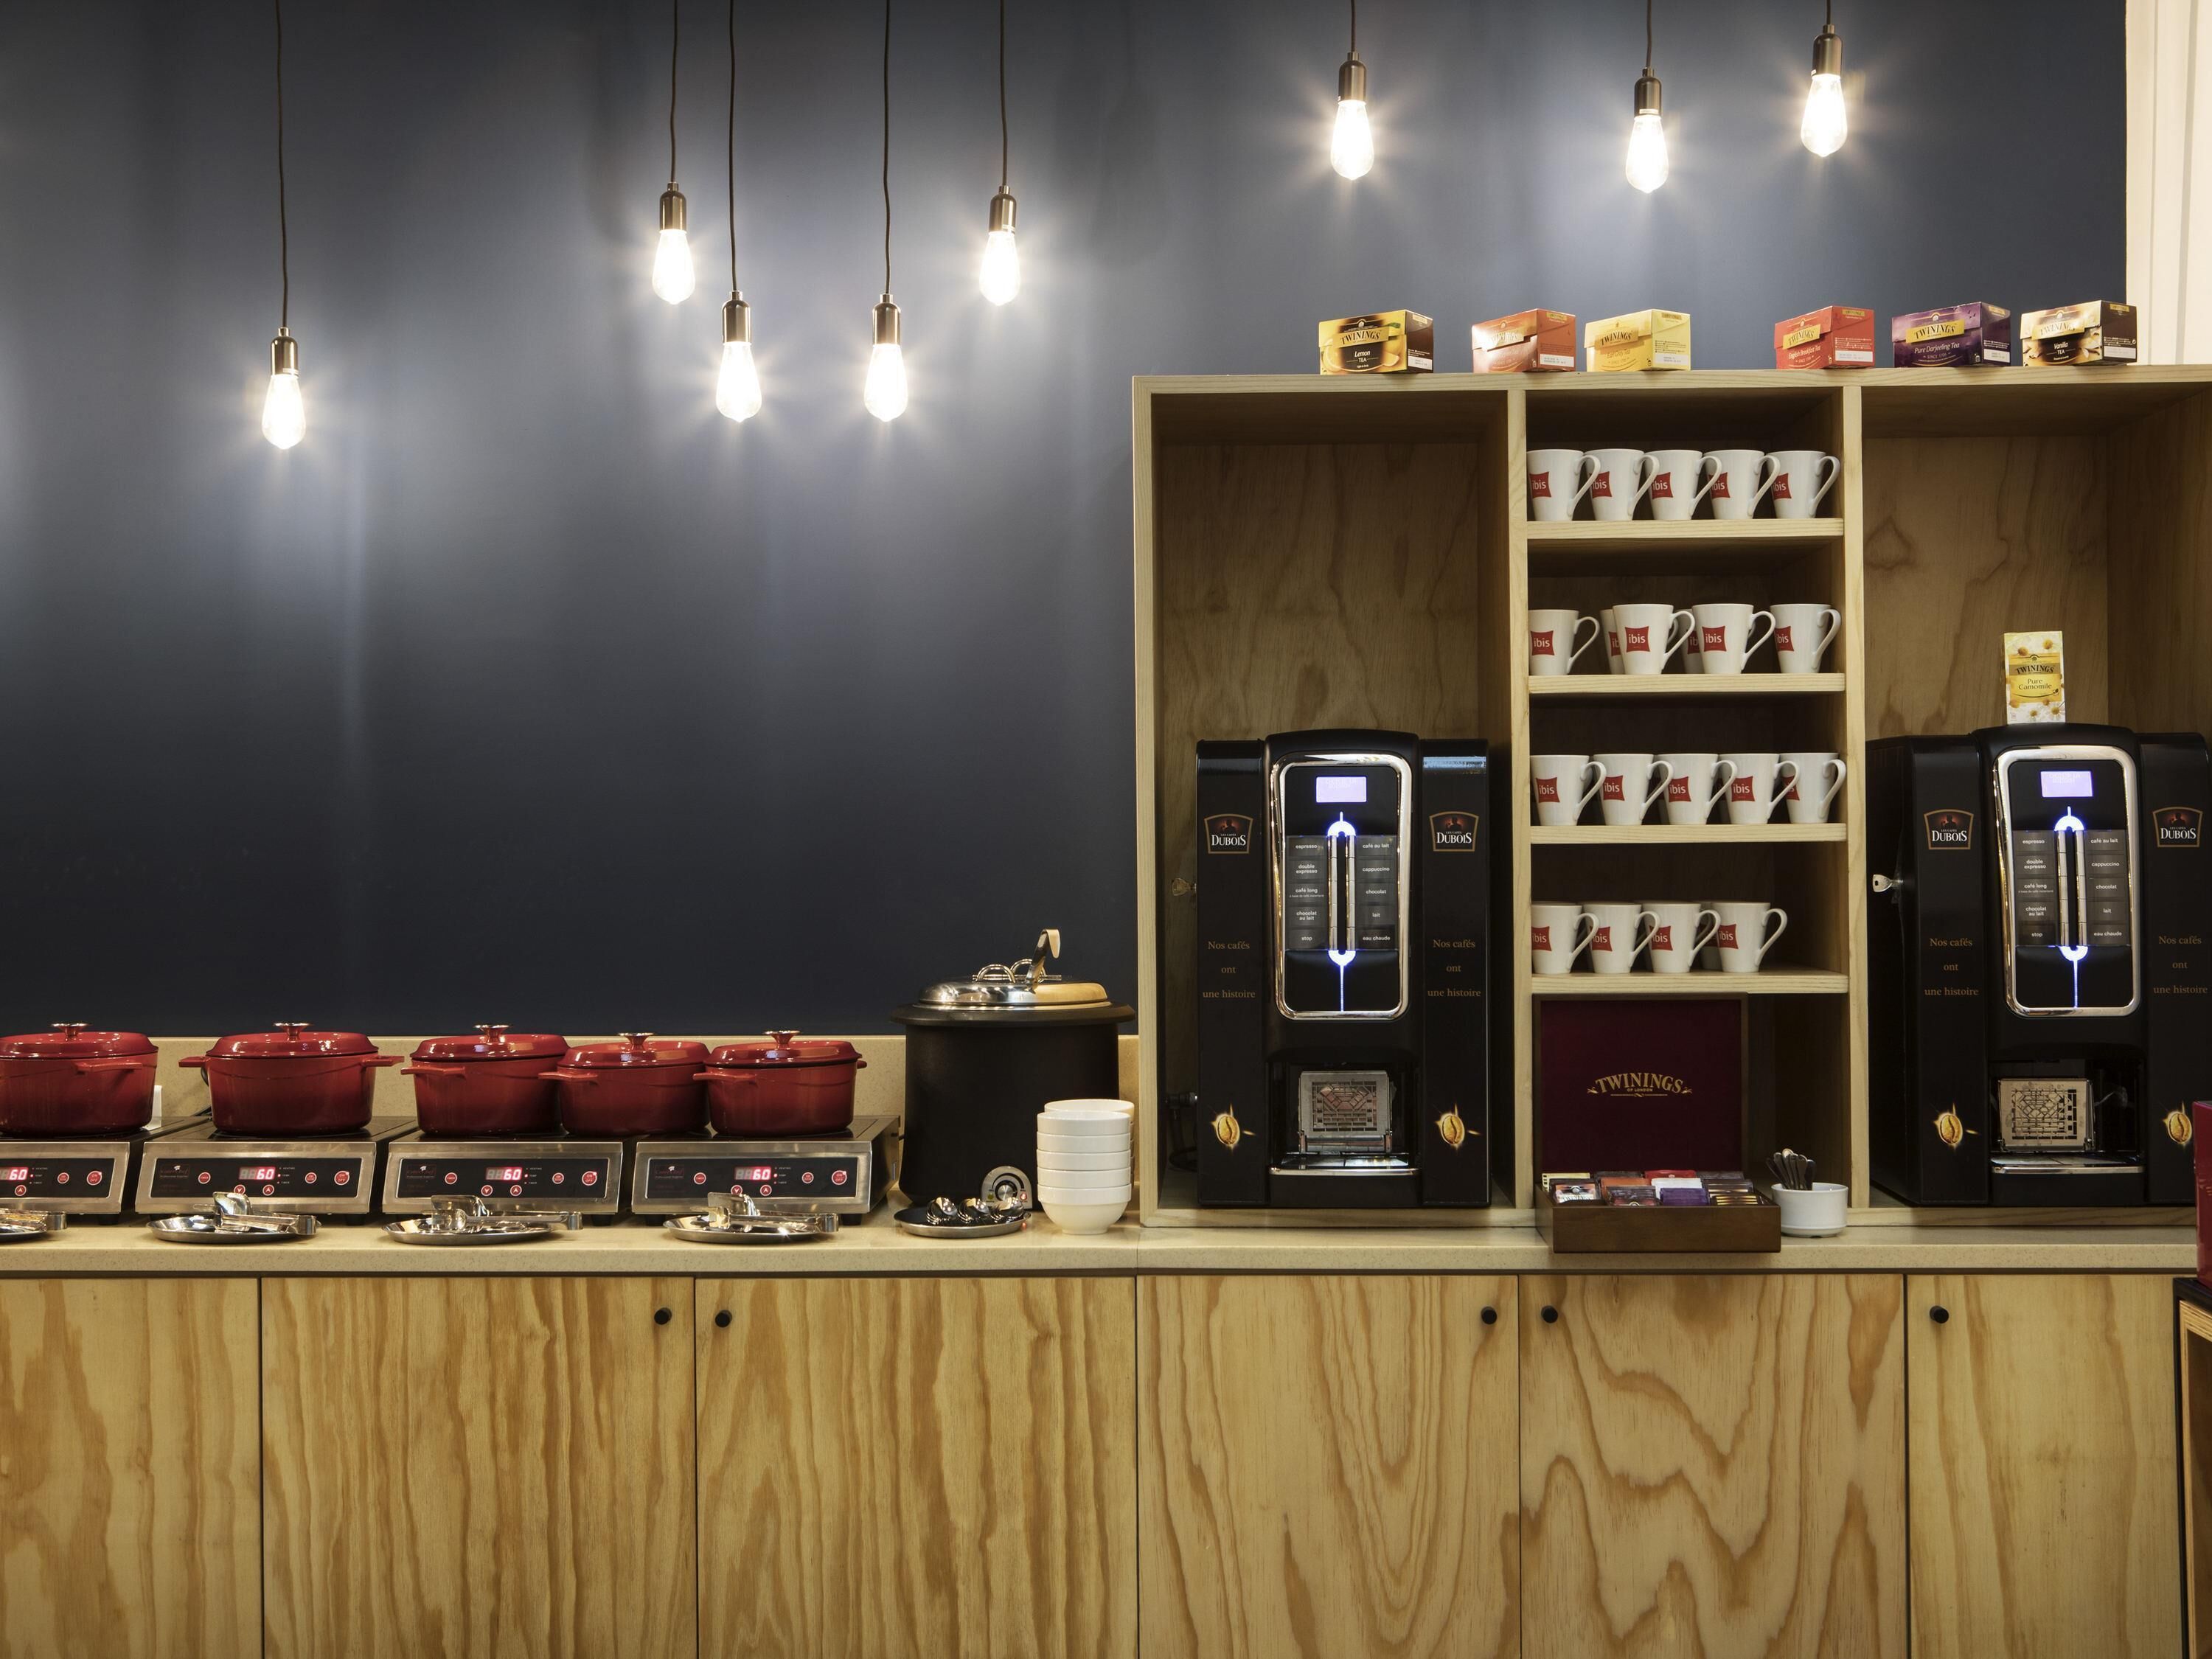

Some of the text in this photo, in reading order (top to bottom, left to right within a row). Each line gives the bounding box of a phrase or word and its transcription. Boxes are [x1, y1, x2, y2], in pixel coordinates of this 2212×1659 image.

[1914, 324, 1955, 339] TWININGS
[1340, 330, 1380, 345] TWININGS
[1599, 331, 1632, 346] TWININGS
[1788, 330, 1815, 346] TWININGS
[1914, 347, 1926, 355] Pure
[1927, 343, 1951, 352] Darjeeling
[2053, 341, 2068, 349] Vanilla
[1354, 349, 1371, 358] Lemon
[1788, 349, 1801, 360] English
[1533, 479, 1546, 490] ibis
[1593, 479, 1607, 490] ibis
[1653, 480, 1668, 490] ibis
[1711, 481, 1725, 490] ibis
[1773, 481, 1787, 491] ibis
[1534, 638, 1550, 647] ibis
[1629, 633, 1645, 644] ibis
[1705, 633, 1722, 643] ibis
[1775, 634, 1789, 643] ibis
[2016, 664, 2054, 675] TWININGS
[1540, 785, 1555, 795] ibis
[1604, 782, 1620, 793] ibis
[1669, 784, 1686, 794] ibis
[1733, 784, 1750, 794] ibis
[1436, 832, 1472, 844] DUBOIS
[1932, 830, 1967, 842] DUBOIS
[2160, 827, 2197, 839] DUBOIS
[1211, 834, 1246, 846] DUBOIS
[1532, 933, 1547, 943] ibis
[1652, 933, 1668, 942] ibis
[1719, 931, 1733, 941] ibis
[2158, 935, 2202, 945] Nos cafés
[1208, 940, 1251, 950] Nos cafés
[1433, 939, 1475, 948] Nos cafés
[1930, 937, 1973, 947] Nos cafés
[1943, 963, 1959, 971] ont
[1222, 990, 1256, 998] histoire
[1447, 988, 1481, 997] histoire
[1944, 987, 1980, 995] histoire
[2173, 985, 2208, 994] histoire
[1595, 1072, 1684, 1093] TWININGS
[9, 1169, 28, 1180] 60
[256, 1168, 275, 1180] 60
[503, 1168, 522, 1180] 60
[752, 1168, 771, 1180] 60
